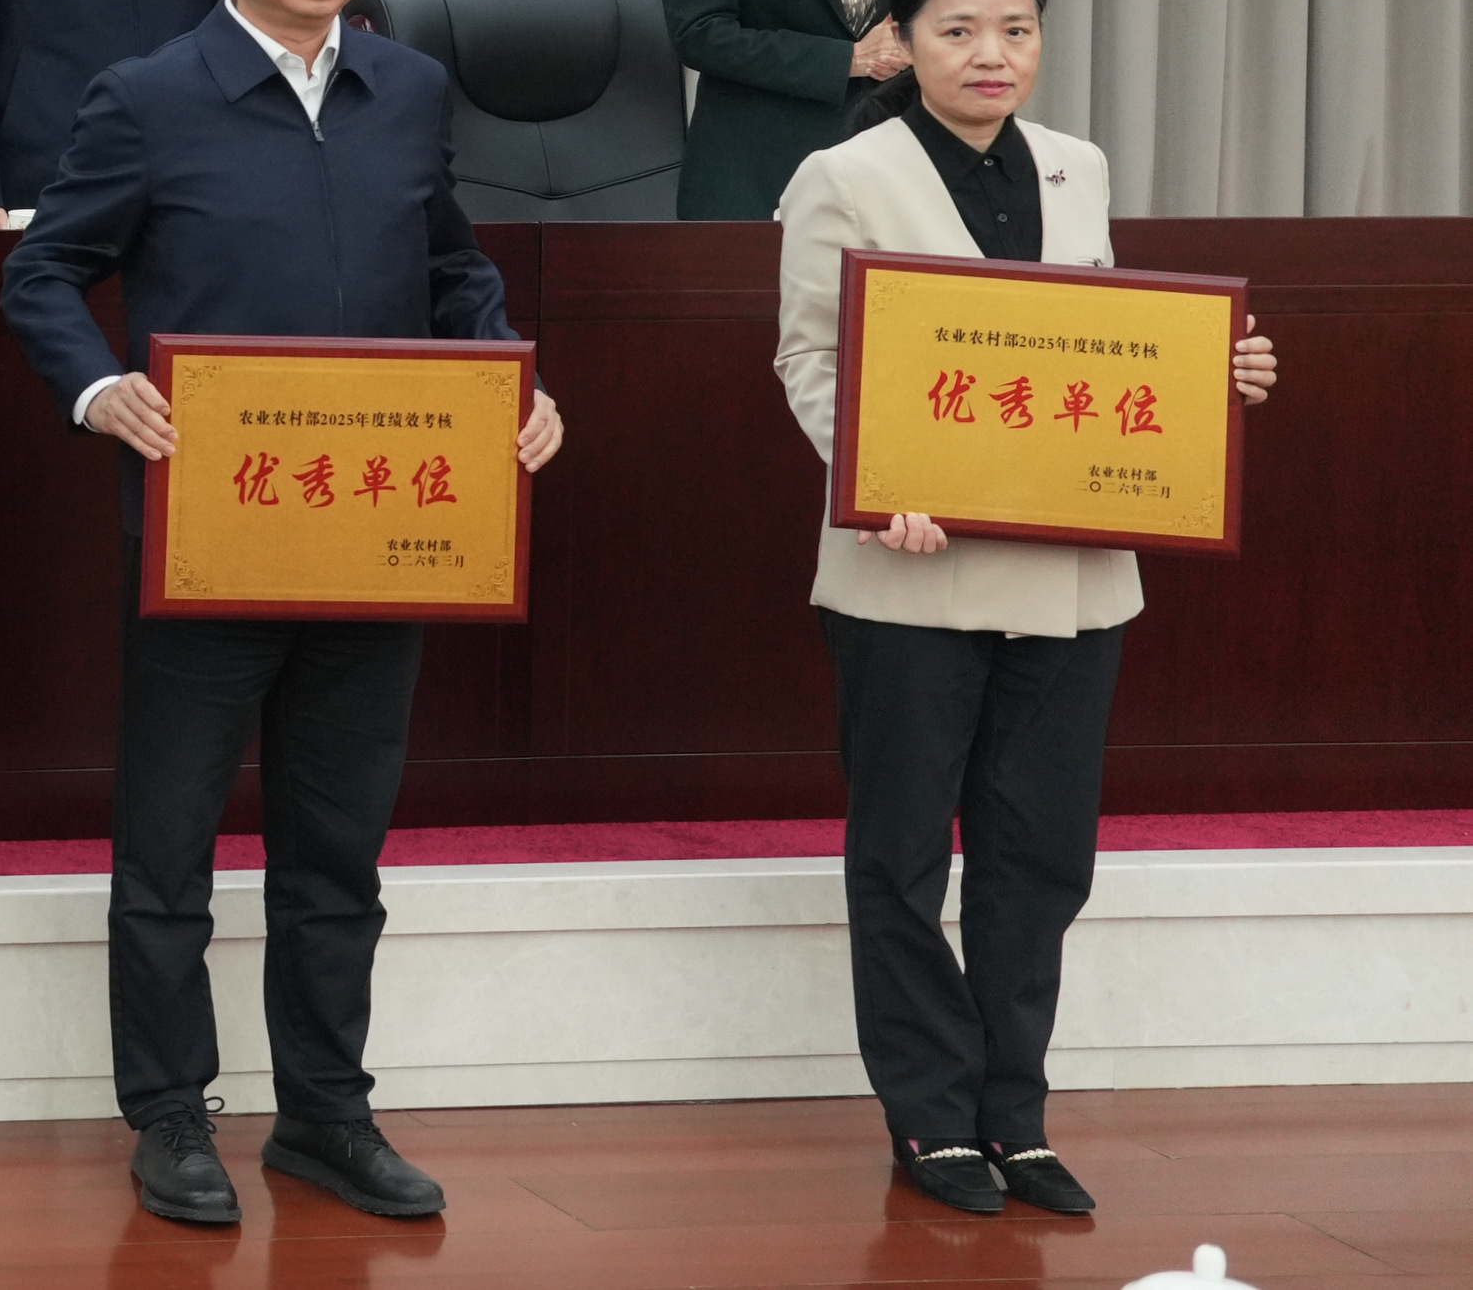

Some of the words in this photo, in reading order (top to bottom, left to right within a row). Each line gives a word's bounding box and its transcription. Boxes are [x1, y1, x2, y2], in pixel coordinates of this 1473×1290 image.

[934, 327, 1159, 359] 农业农村部2025年度绩效考核
[928, 369, 1163, 436] 优秀单位
[239, 410, 453, 429] 农业农村部2025年度绩效考核
[233, 452, 457, 508] 优秀单位
[1089, 465, 1157, 481] 农业农村部
[1075, 480, 1170, 499] 二〇二六年三月
[387, 539, 451, 552] 农业农村部
[376, 555, 464, 568] 二〇二六年三月
